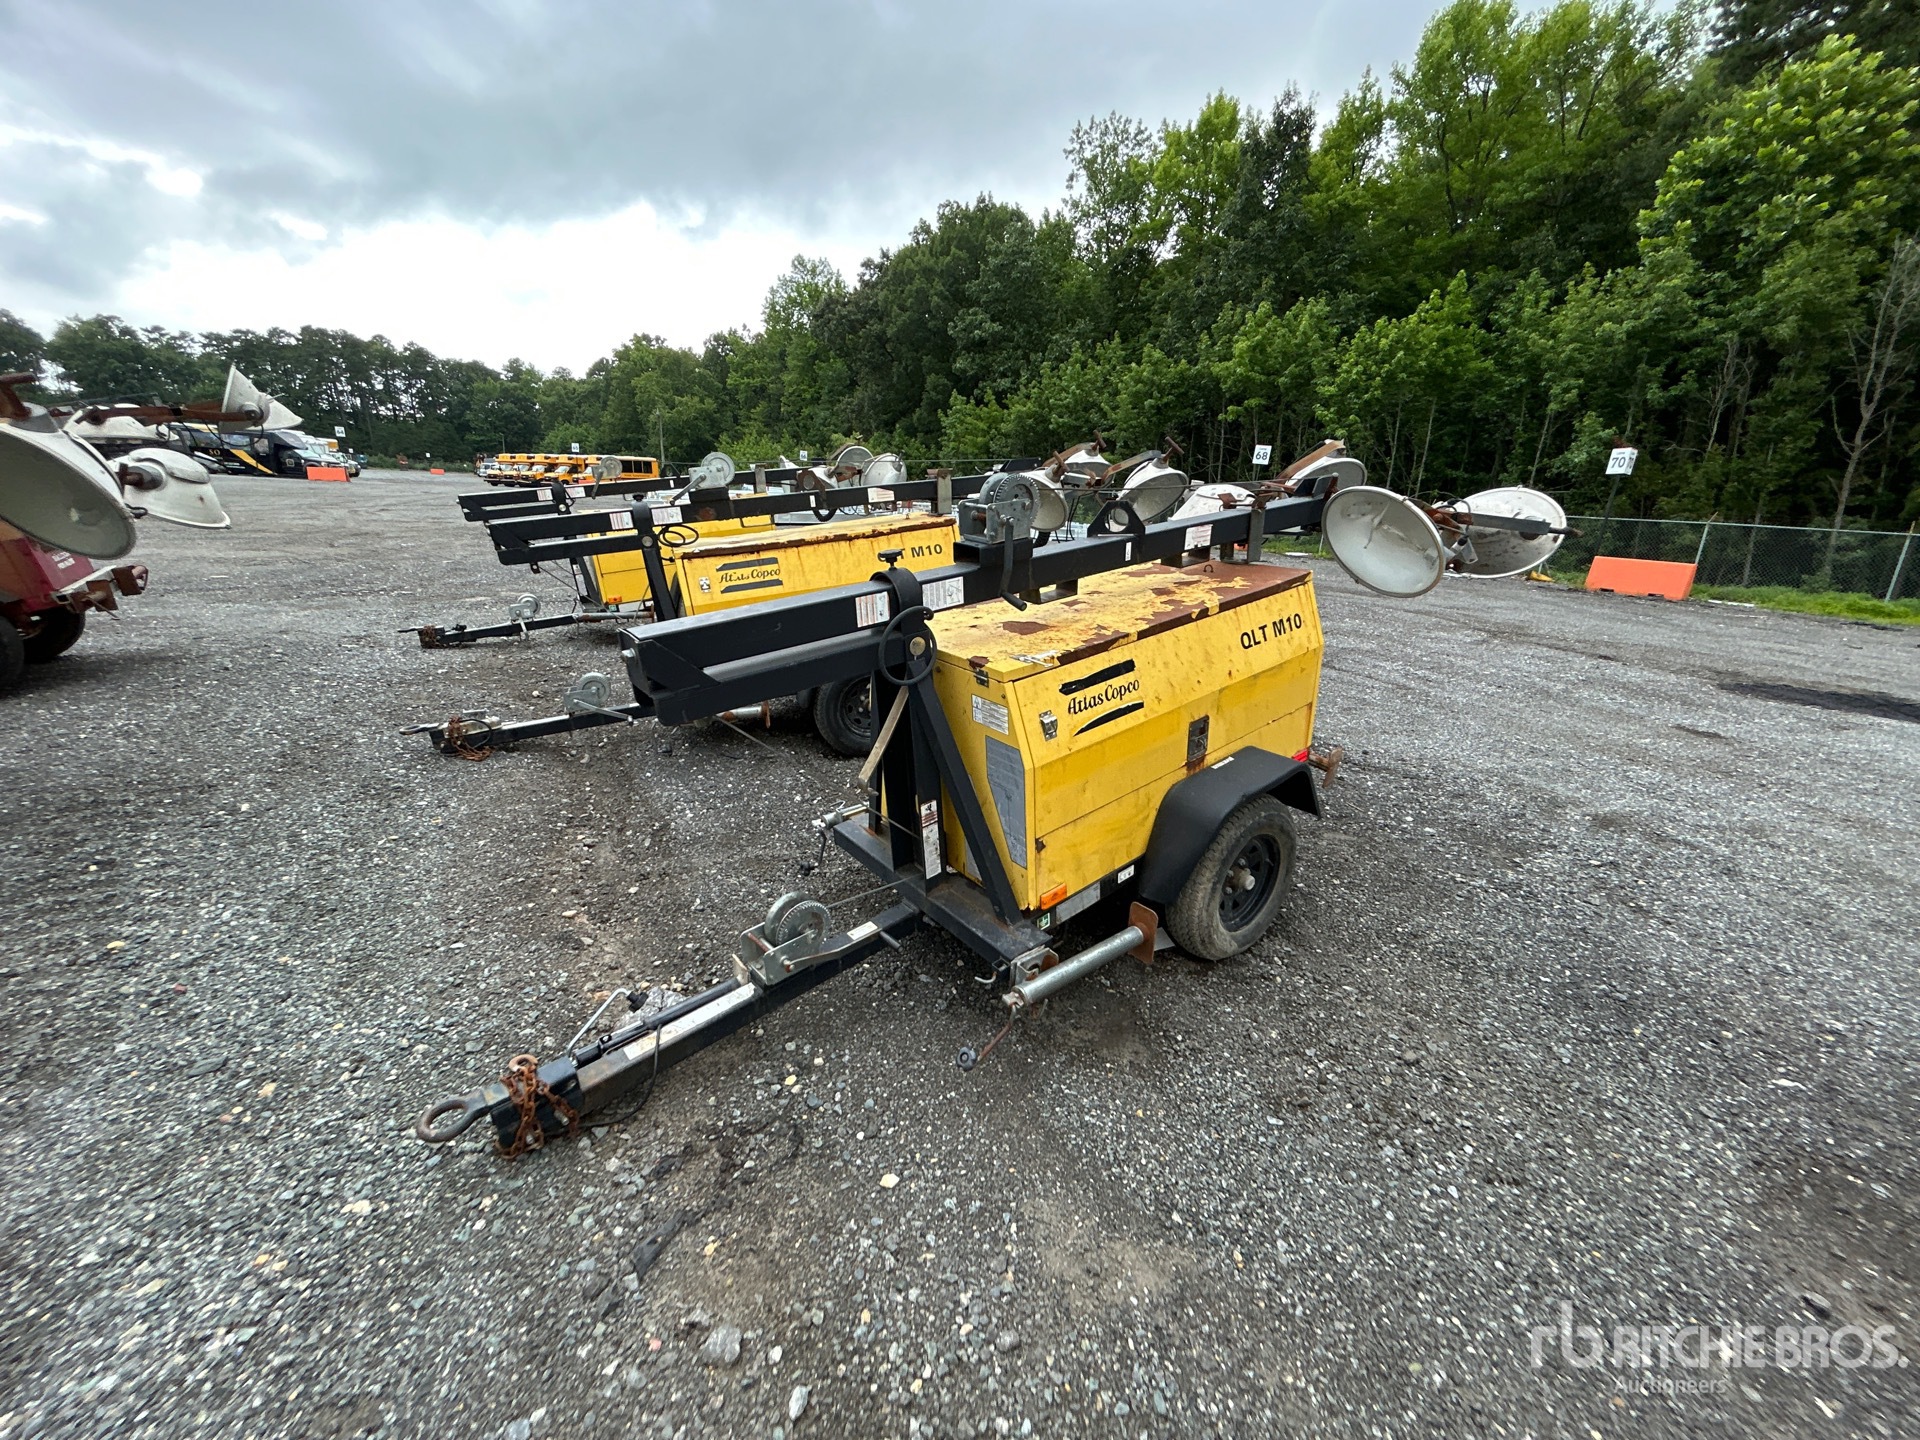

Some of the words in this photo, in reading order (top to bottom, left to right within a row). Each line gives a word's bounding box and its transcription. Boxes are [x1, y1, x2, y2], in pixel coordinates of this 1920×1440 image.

[1255, 451, 1268, 461] 68
[1611, 456, 1626, 468] 70
[911, 543, 943, 558] M10
[750, 568, 781, 579] Copco
[1240, 624, 1267, 650] QLT
[1271, 613, 1302, 638] M10
[1067, 692, 1104, 715] Atlas
[1104, 679, 1140, 701] Copco
